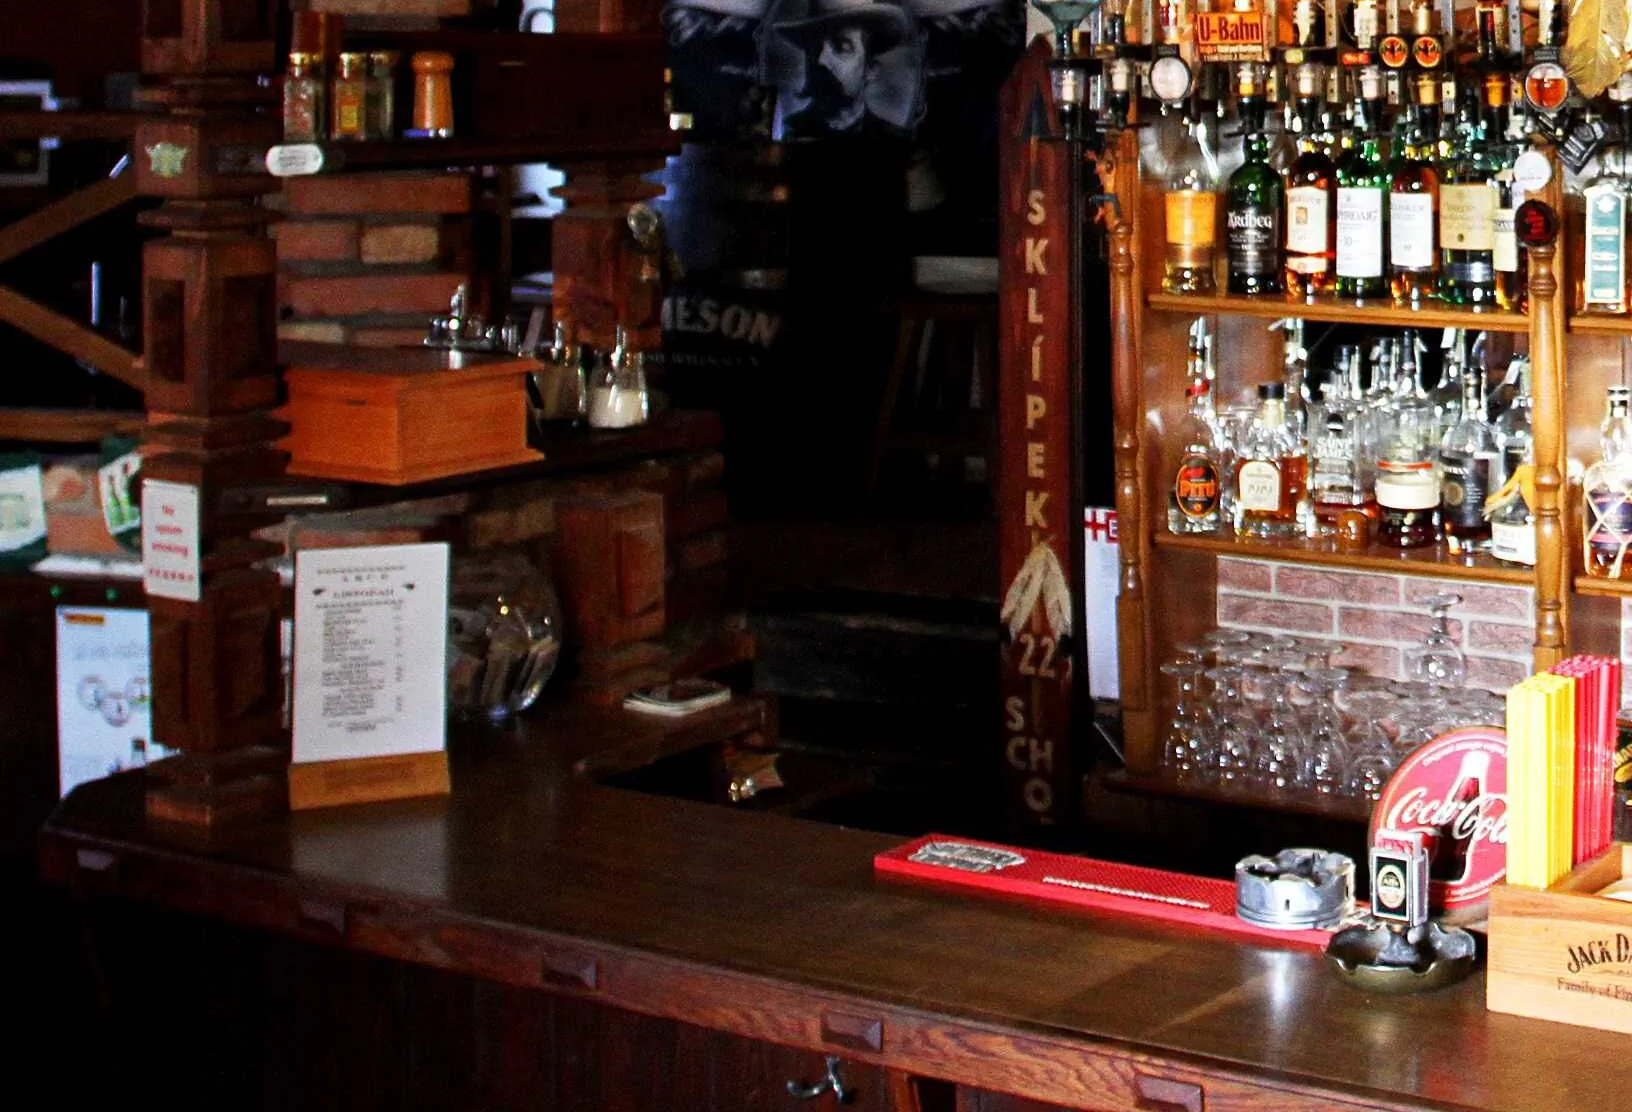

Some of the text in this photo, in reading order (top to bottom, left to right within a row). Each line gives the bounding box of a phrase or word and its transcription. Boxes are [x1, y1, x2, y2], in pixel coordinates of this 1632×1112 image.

[1199, 15, 1260, 42] U-Bahn
[1024, 190, 1048, 528] SKLÍPEK
[1019, 632, 1054, 679] 22
[1567, 940, 1613, 975] JACK
[1556, 976, 1597, 997] Family
